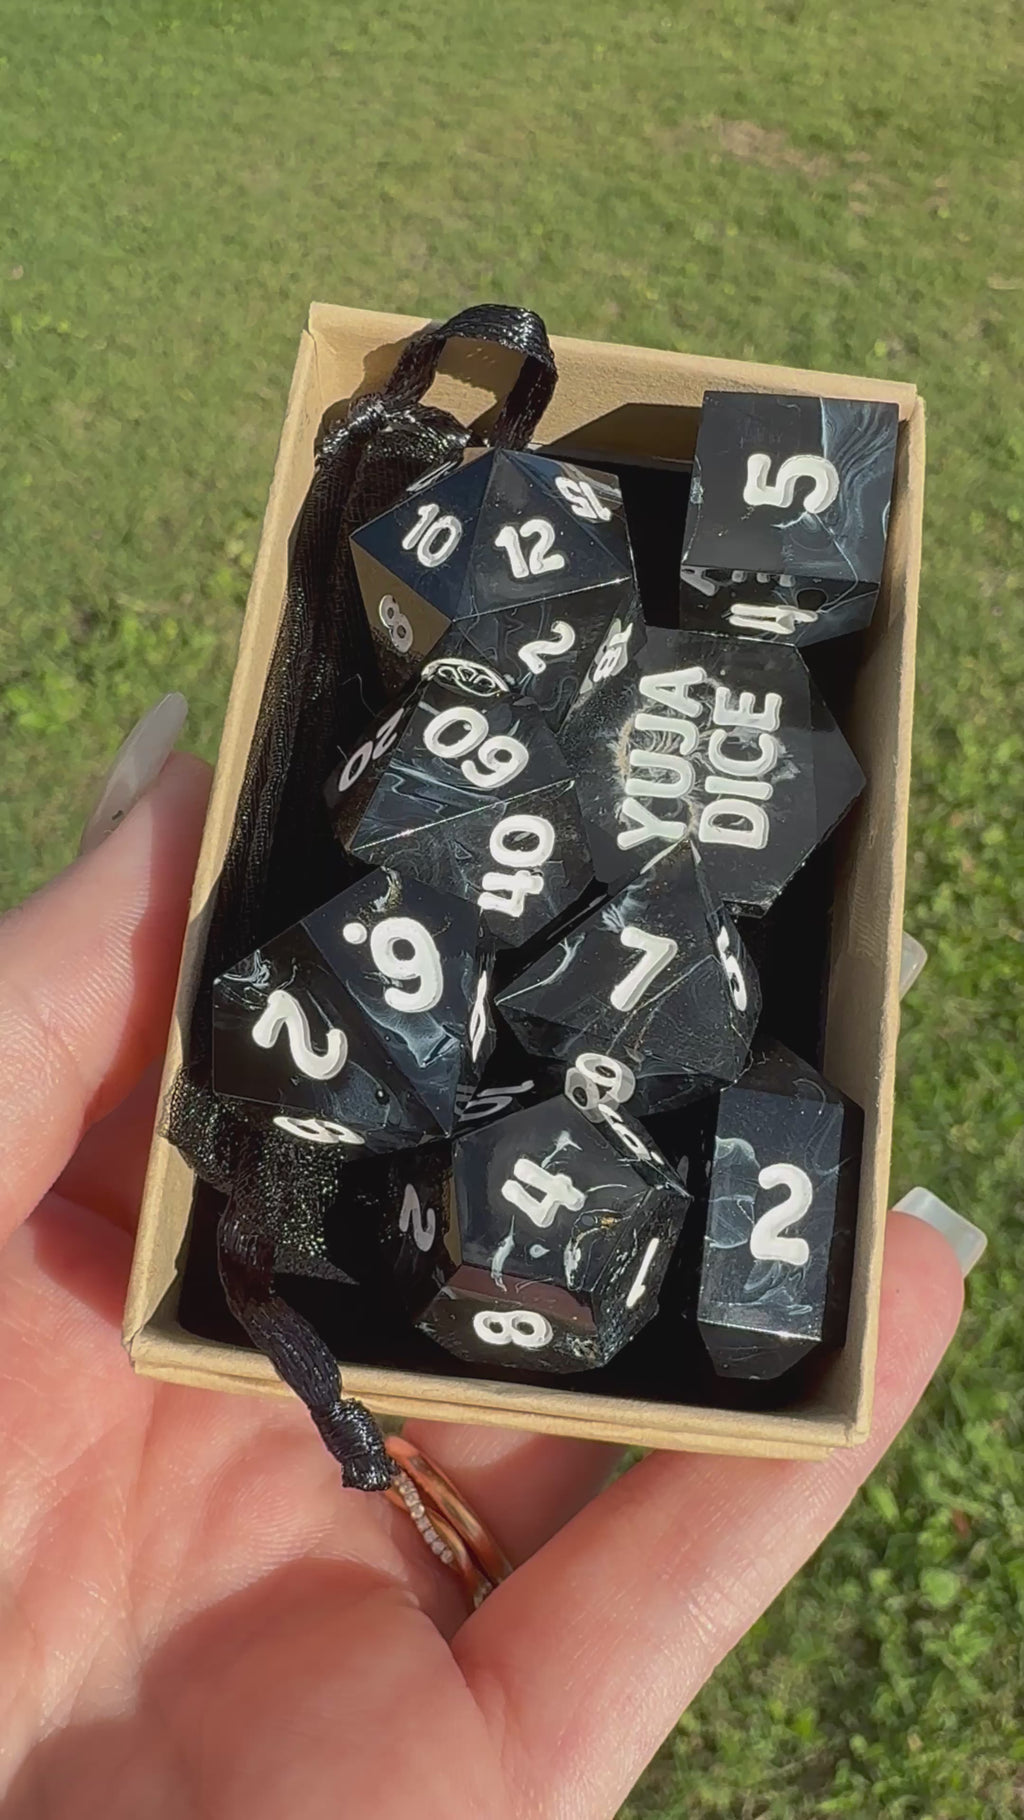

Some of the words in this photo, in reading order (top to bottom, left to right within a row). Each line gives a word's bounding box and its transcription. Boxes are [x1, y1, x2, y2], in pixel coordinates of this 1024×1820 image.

[743, 453, 840, 515] 5
[402, 503, 462, 568] 10
[495, 519, 566, 579] 12
[378, 594, 414, 653] 8
[518, 620, 576, 675] 2
[616, 666, 707, 851] YUJA
[698, 686, 783, 850] DICE
[477, 814, 556, 918] 40
[609, 926, 678, 1012] 7
[252, 989, 348, 1080] 2
[399, 1183, 436, 1252] 2
[501, 1158, 586, 1228] 4
[750, 1162, 813, 1266] 2
[473, 1309, 554, 1348] 8
